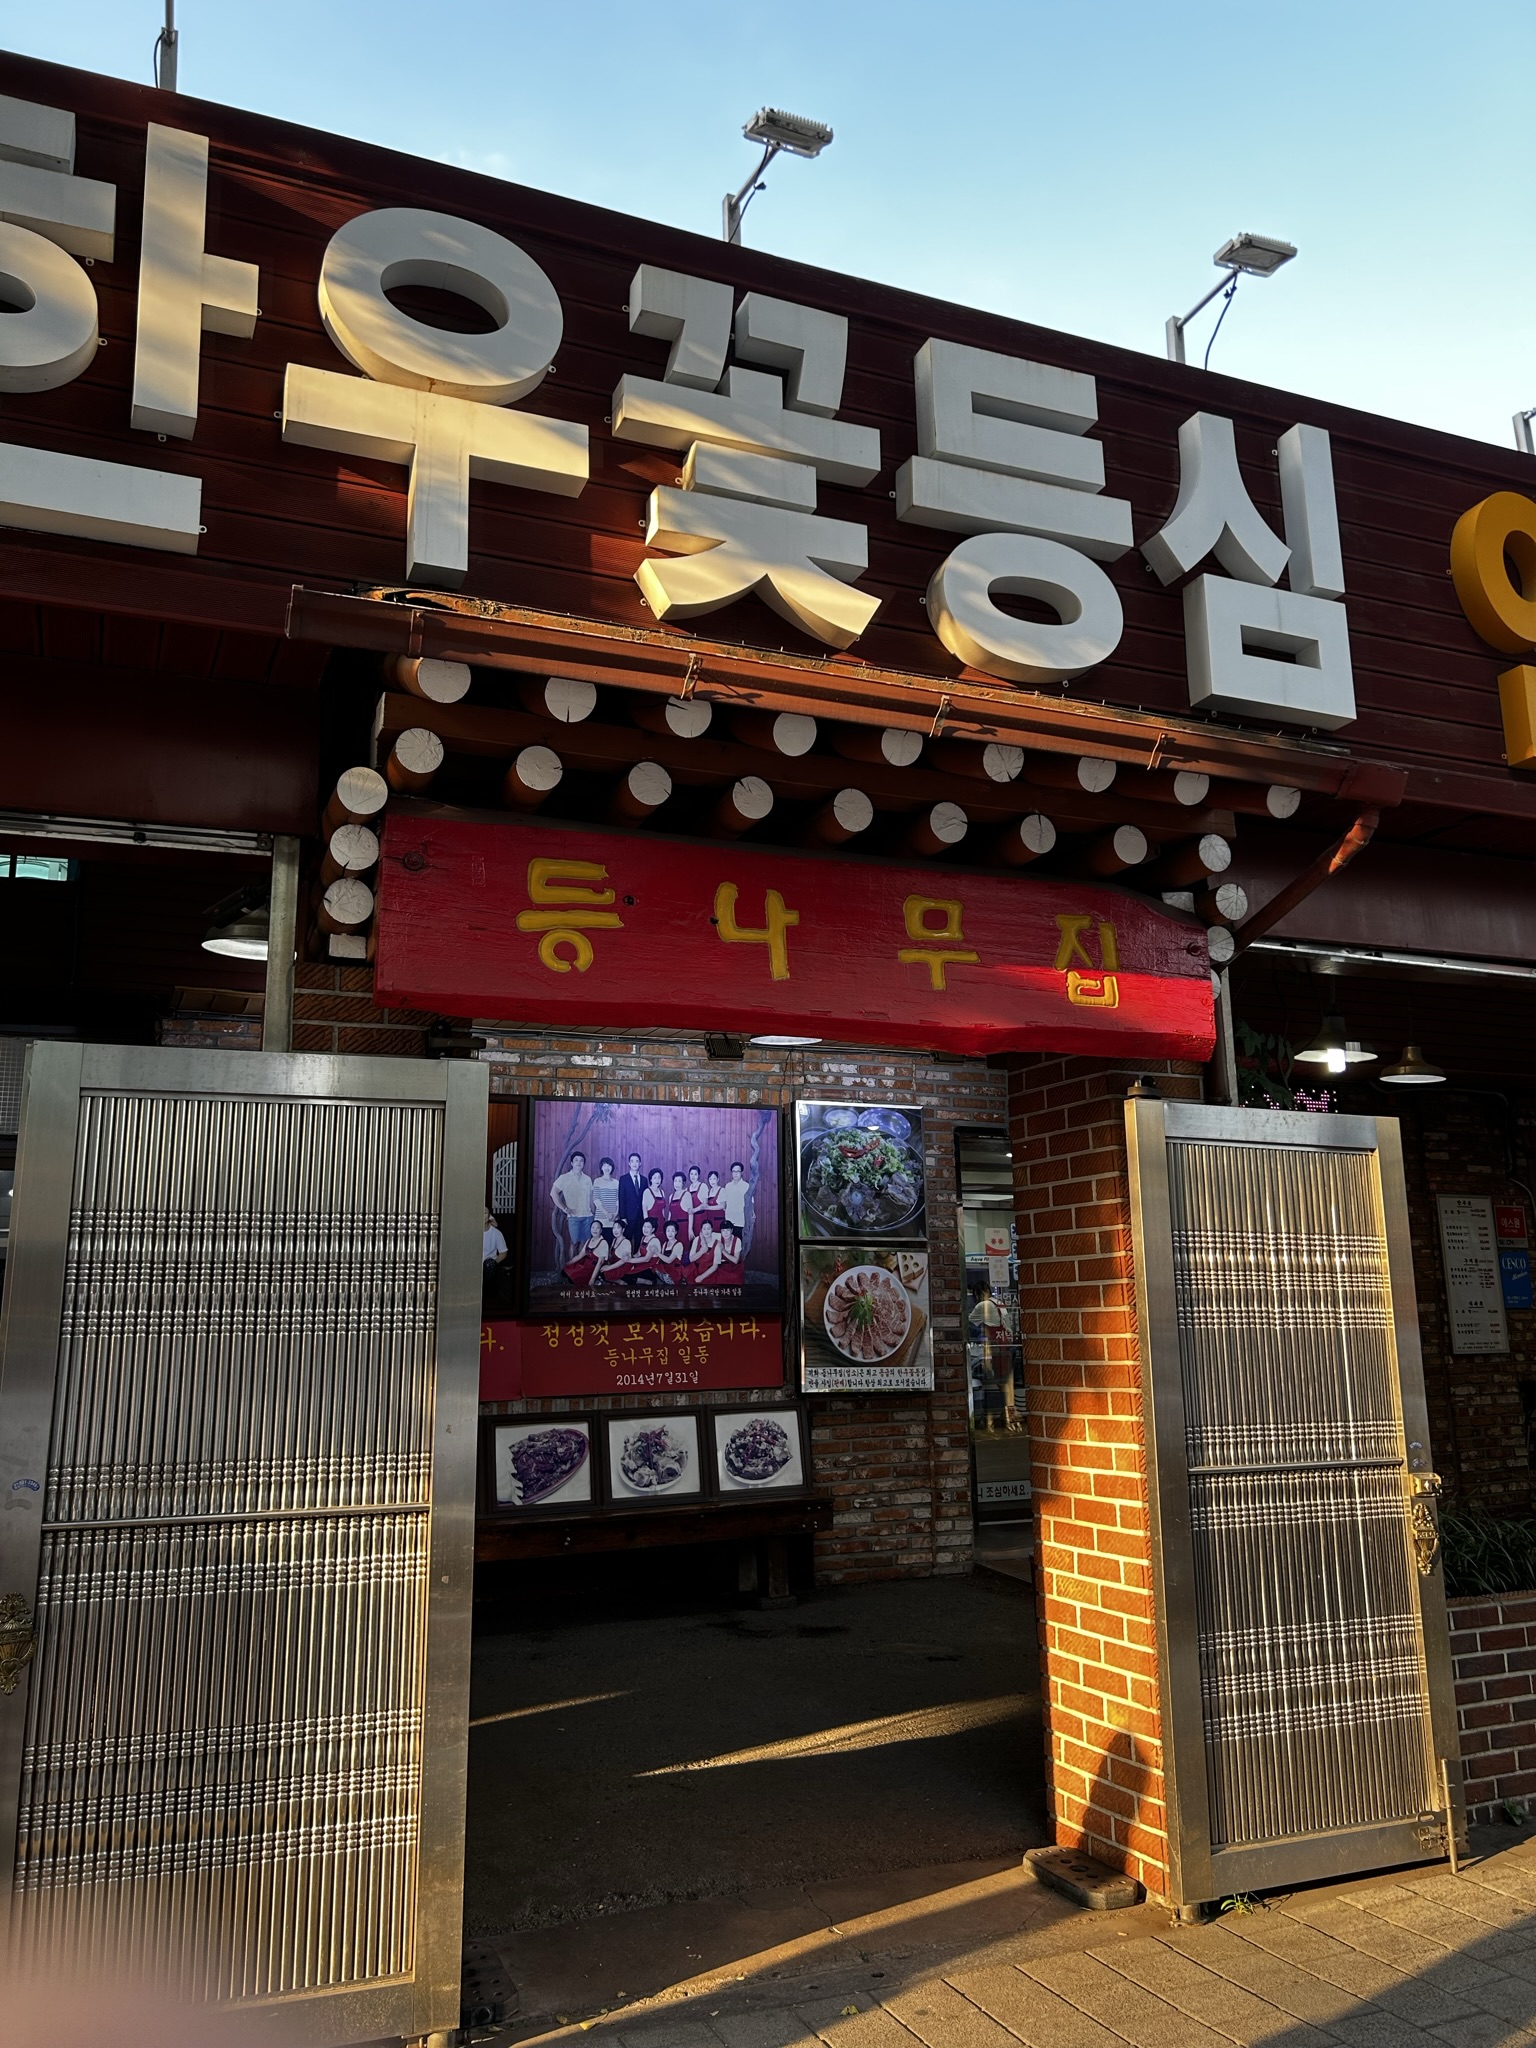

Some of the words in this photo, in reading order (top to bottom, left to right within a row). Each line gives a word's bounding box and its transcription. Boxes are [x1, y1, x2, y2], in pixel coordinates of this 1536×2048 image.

[516, 857, 1121, 1009] 등나무집
[1501, 1217, 1521, 1229] 에스원
[1502, 1257, 1527, 1270] CESCO
[626, 1289, 641, 1298] 정성껏
[540, 1319, 610, 1348] 정성껏
[622, 1316, 767, 1343] 모시겠습니다.
[603, 1347, 670, 1368] 등나무집
[678, 1345, 710, 1365] 일동
[986, 1484, 1030, 1498] 조심하세요.
